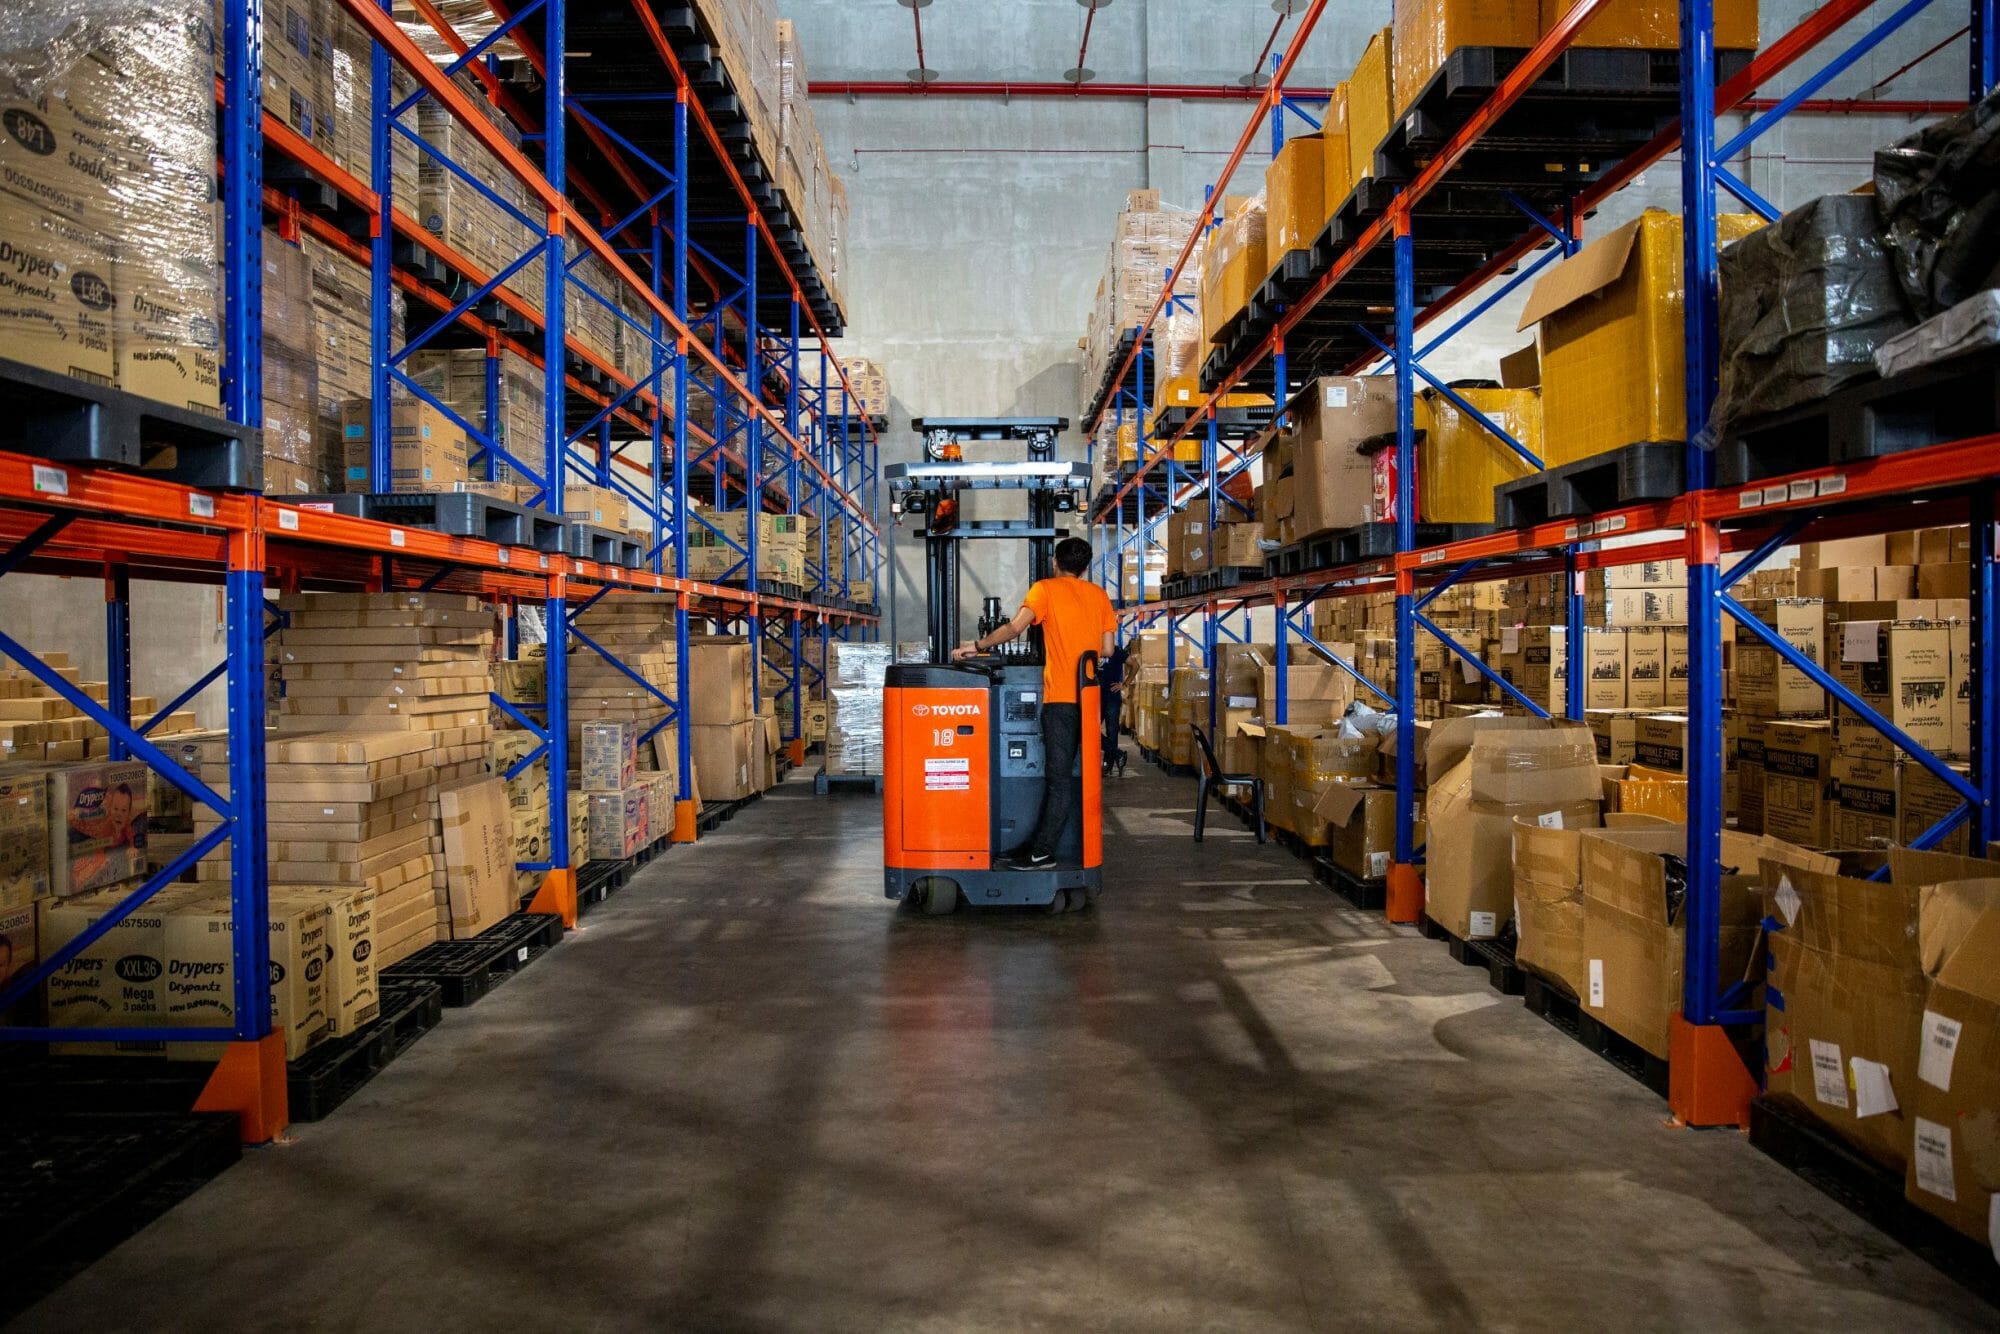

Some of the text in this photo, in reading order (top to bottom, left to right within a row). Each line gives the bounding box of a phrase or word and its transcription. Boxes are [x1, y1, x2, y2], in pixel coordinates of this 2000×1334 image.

[0, 240, 60, 281] Drypers
[931, 705, 980, 715] TOYOTA
[933, 729, 954, 746] 18
[1663, 748, 1679, 760] FREE
[0, 914, 30, 930] 520805
[122, 960, 158, 977] XXL36
[169, 960, 225, 979] Drypers
[51, 976, 100, 991] Drypantz
[169, 981, 222, 996] Drypantz
[123, 987, 155, 1005] Mega
[123, 1002, 156, 1012] 3 packs
